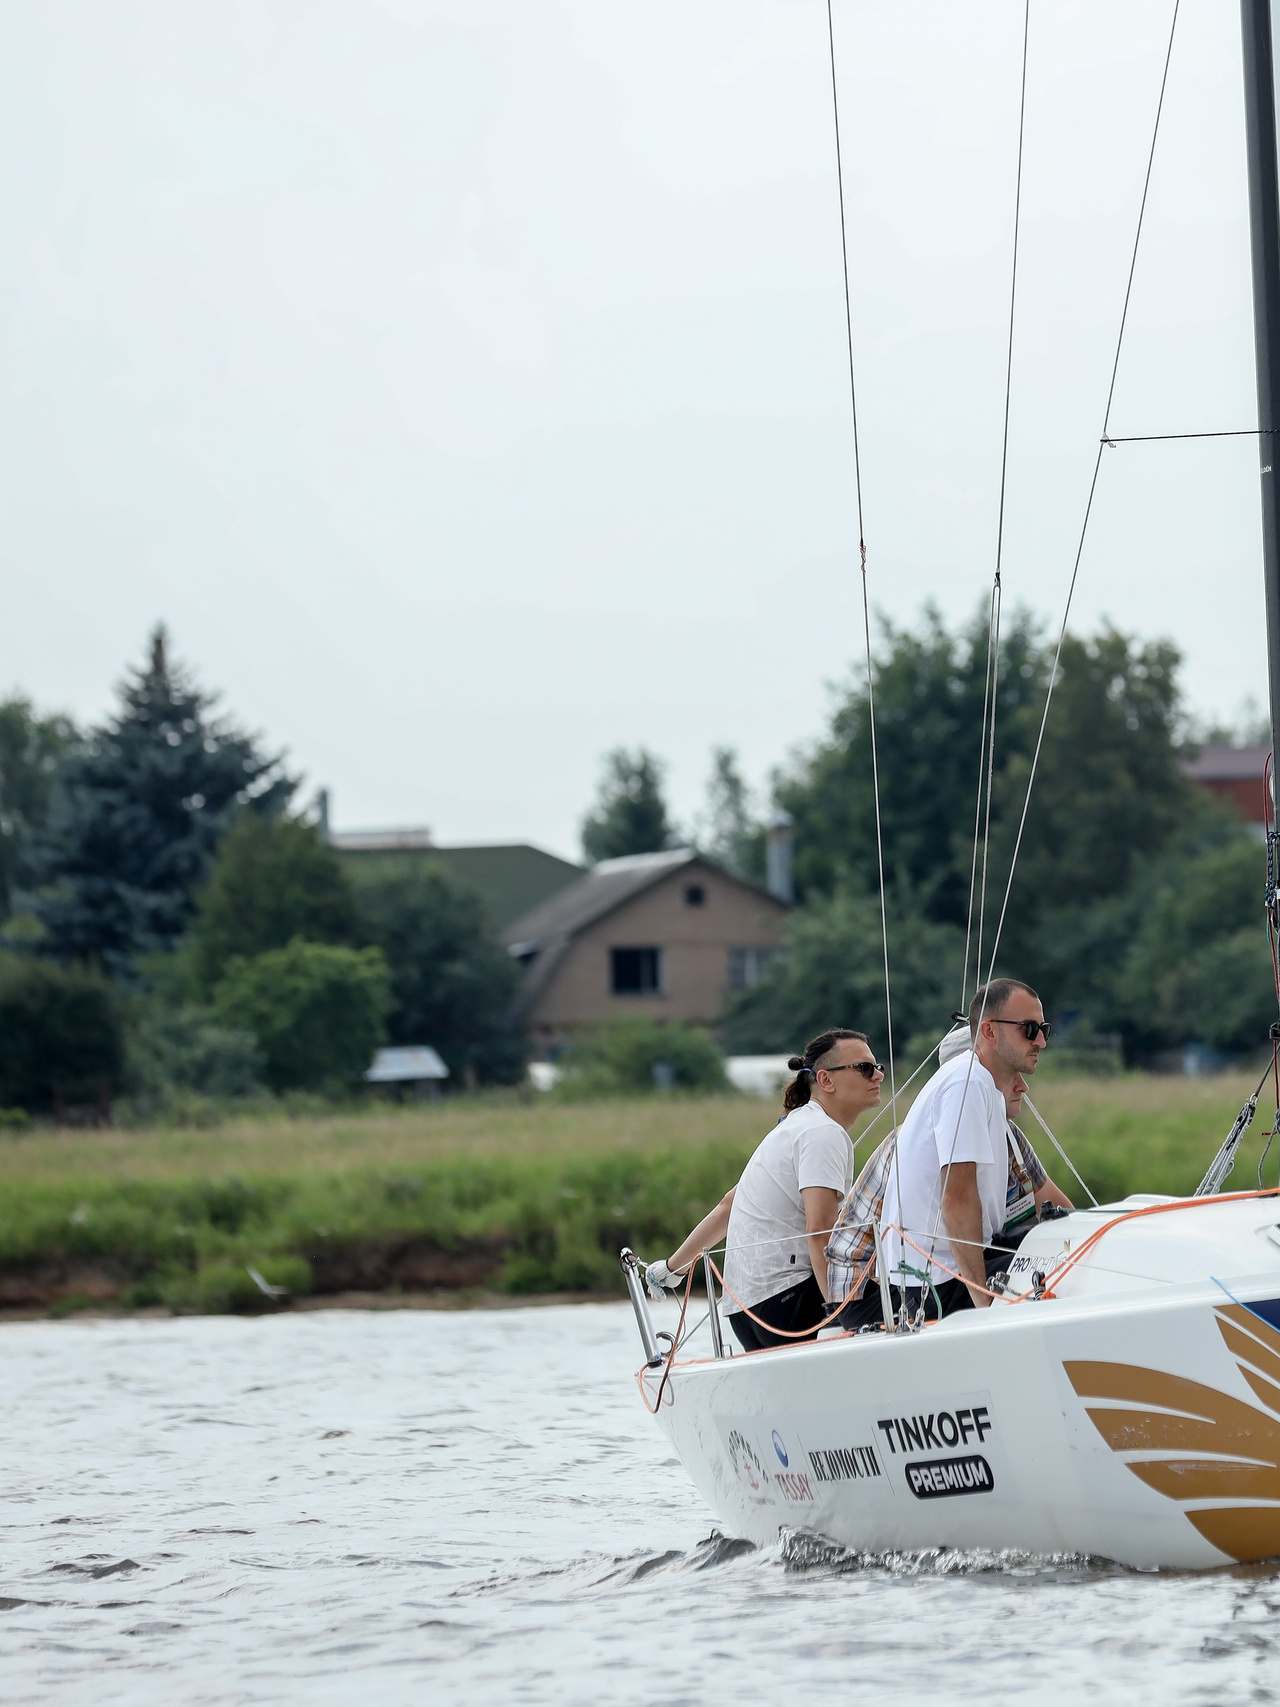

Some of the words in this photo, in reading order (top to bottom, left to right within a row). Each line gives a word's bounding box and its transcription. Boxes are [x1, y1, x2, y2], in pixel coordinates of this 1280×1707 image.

[877, 1407, 992, 1454] TINKOFF
[808, 1446, 882, 1482] ВЕДОМОСТИ
[908, 1461, 990, 1493] PREMIUM
[774, 1473, 814, 1501] TASSAY
